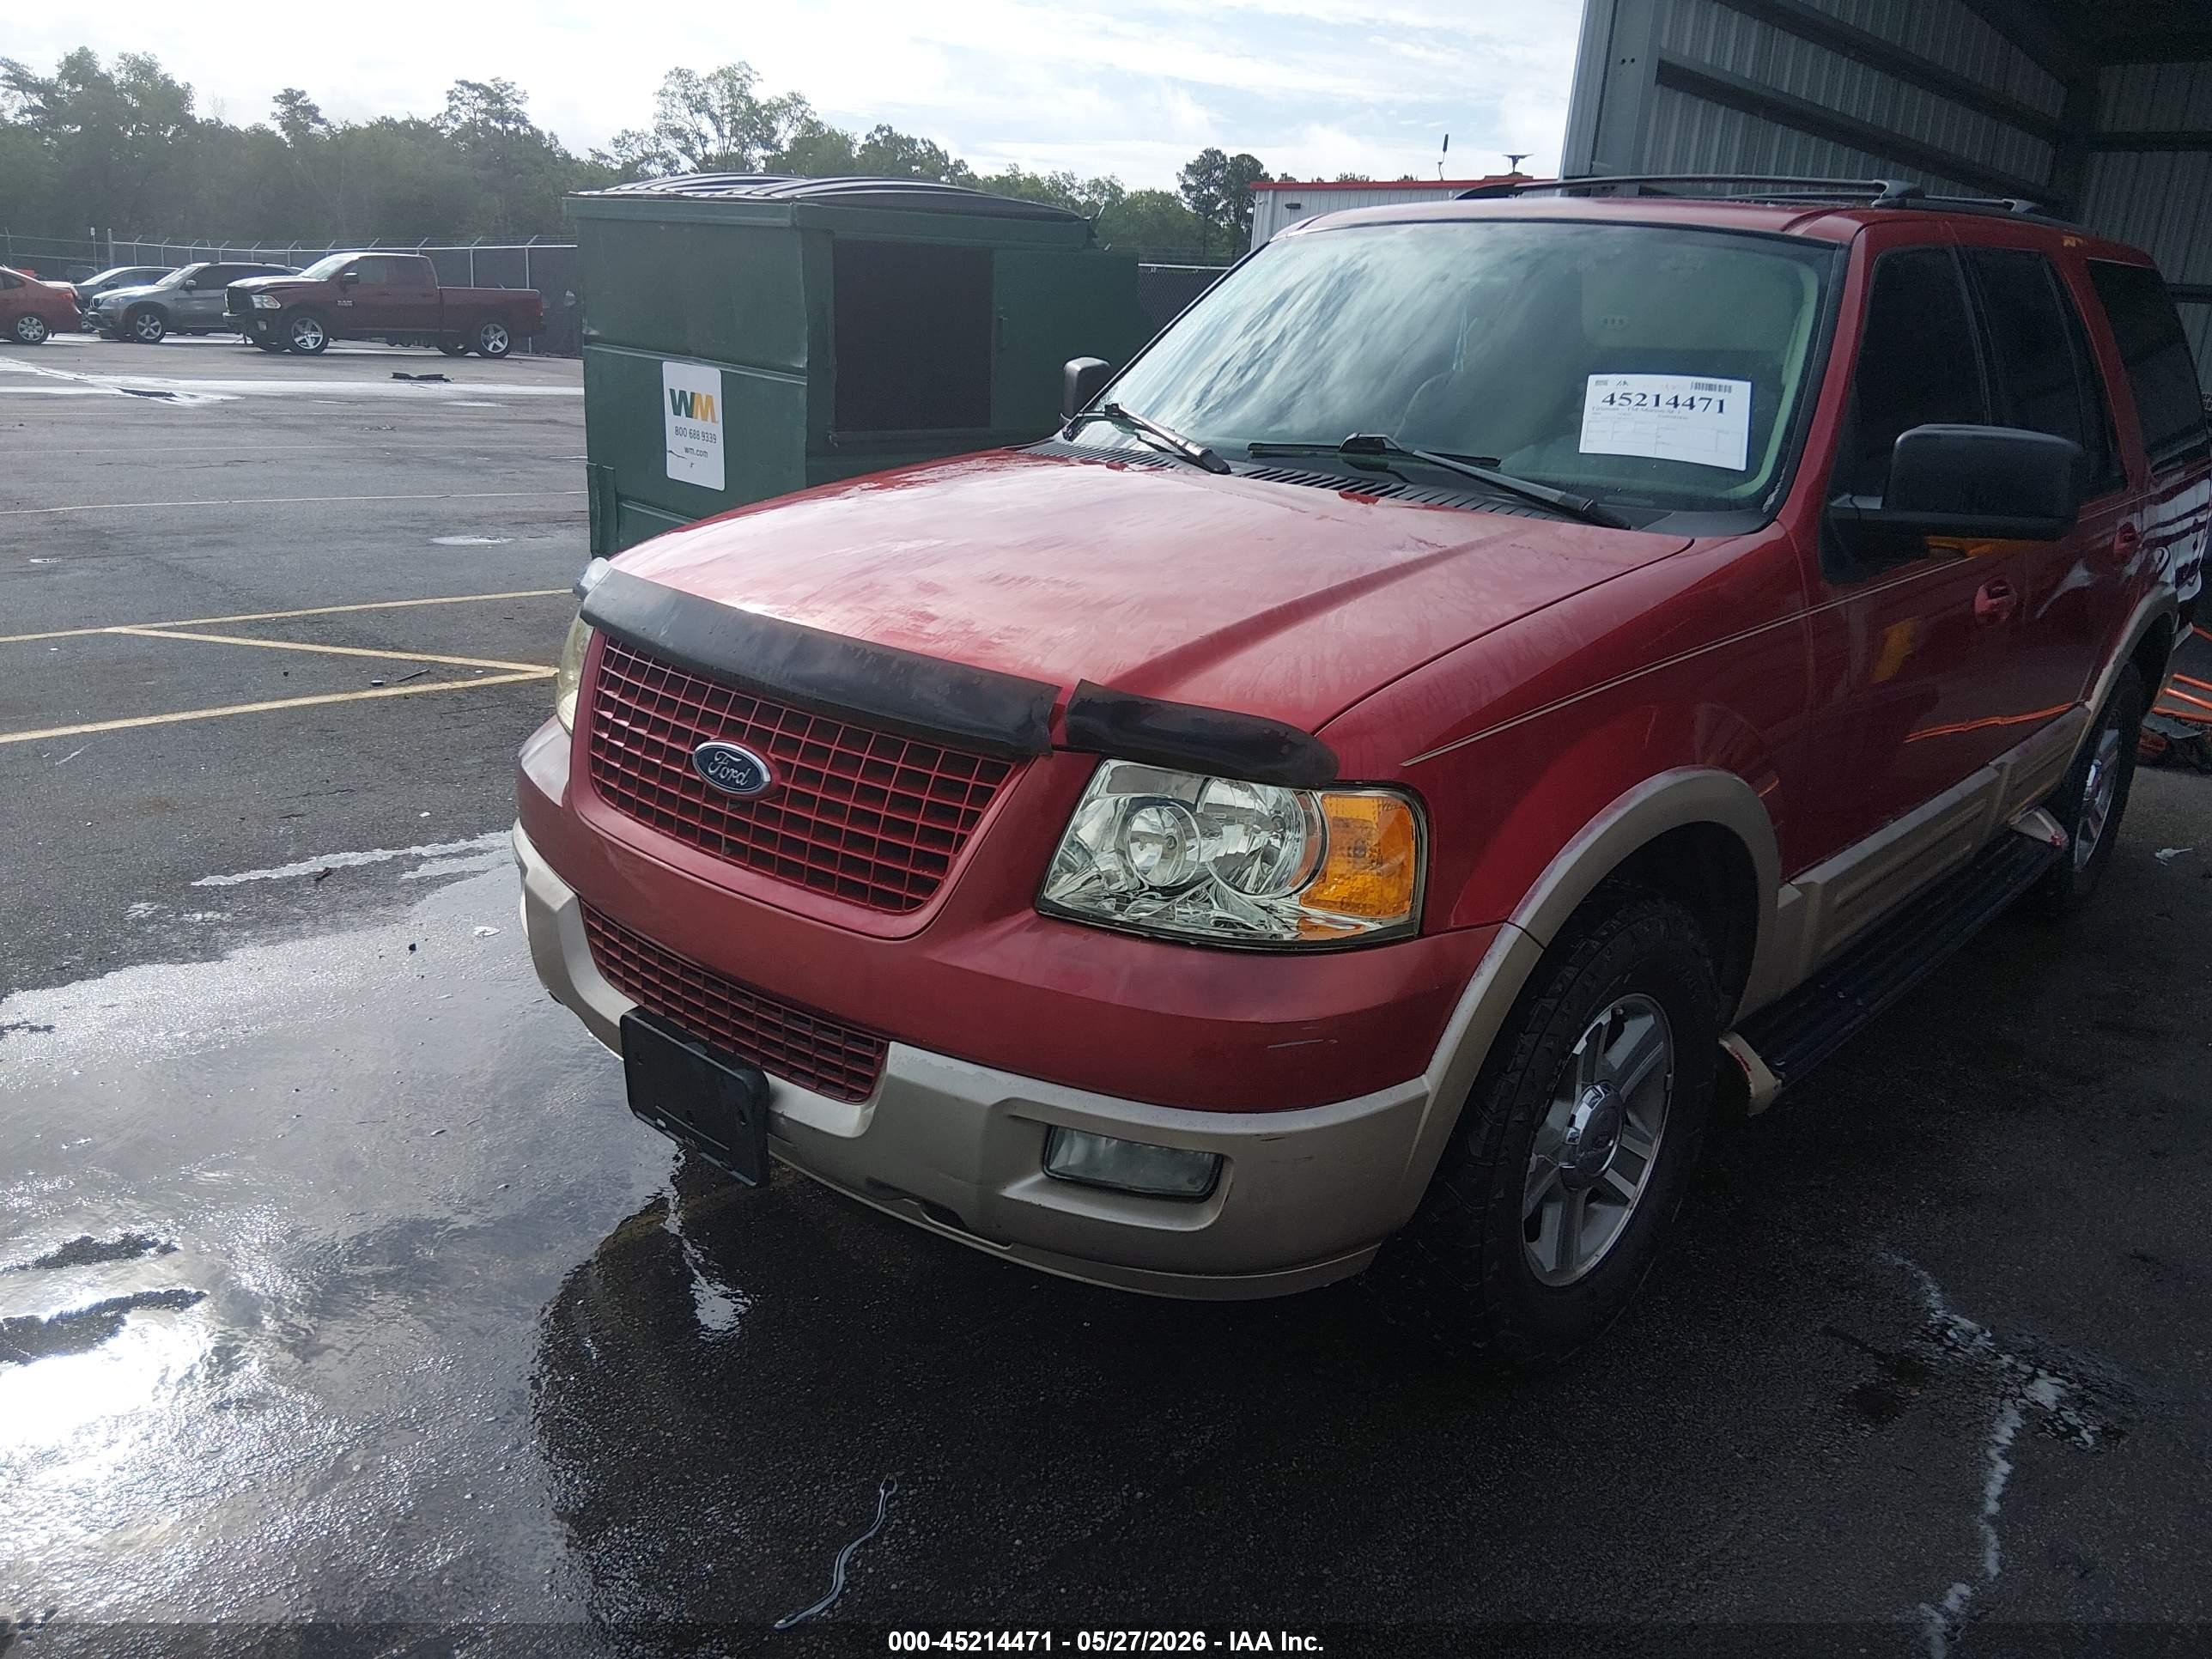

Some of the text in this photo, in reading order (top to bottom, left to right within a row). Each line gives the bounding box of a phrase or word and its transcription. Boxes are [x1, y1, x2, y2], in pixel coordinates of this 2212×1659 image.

[669, 388, 718, 423] WM
[1602, 392, 1724, 414] 45214471
[674, 426, 687, 437] 800
[701, 431, 717, 444] 9339
[684, 447, 708, 459] wm.com
[708, 751, 750, 785] Ford
